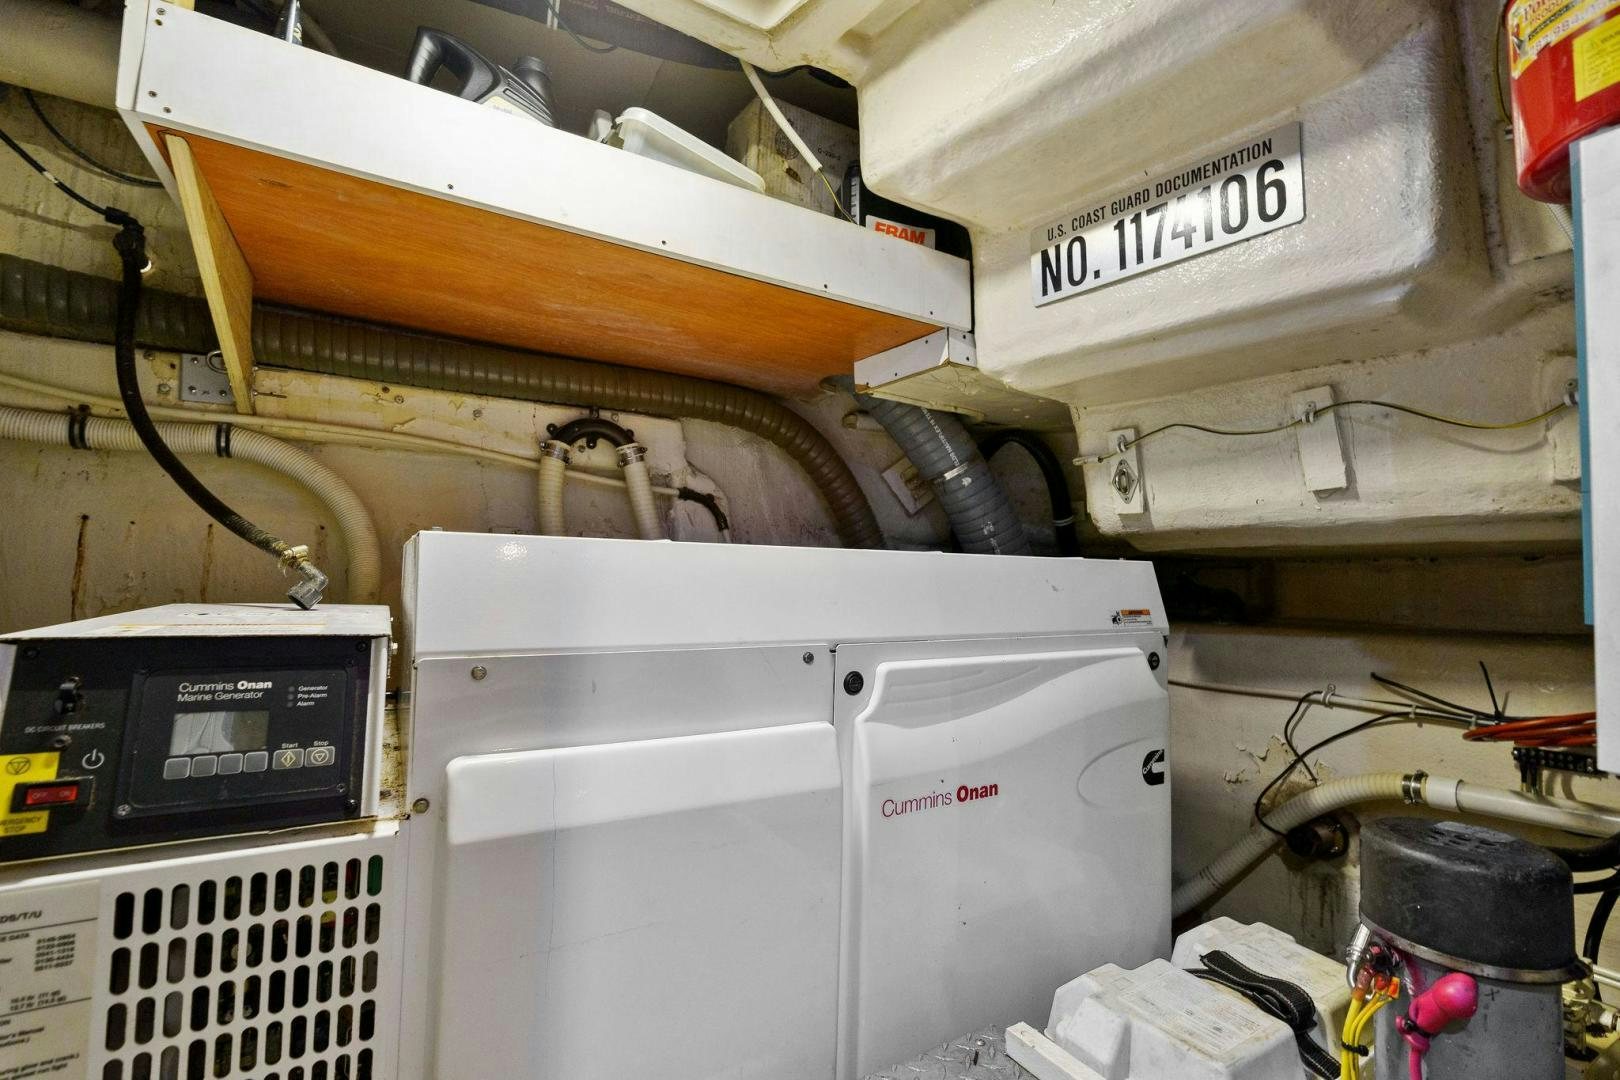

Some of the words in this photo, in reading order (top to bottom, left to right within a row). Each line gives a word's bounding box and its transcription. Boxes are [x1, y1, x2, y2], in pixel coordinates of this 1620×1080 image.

[1047, 224, 1067, 241] U.S.
[1071, 205, 1107, 231] COAST
[1111, 188, 1150, 216] GUARD
[1155, 138, 1273, 198] DOCUMENTATION
[874, 221, 926, 244] FRAM
[1040, 235, 1101, 297] NO.
[1113, 159, 1288, 271] 1174106
[177, 693, 212, 702] Marine
[214, 691, 265, 700] Generator
[178, 681, 235, 693] Cummins
[237, 680, 273, 690] Onan
[68, 722, 106, 731] BREAKERS
[881, 790, 953, 818] Cummins
[956, 782, 999, 803] Onan
